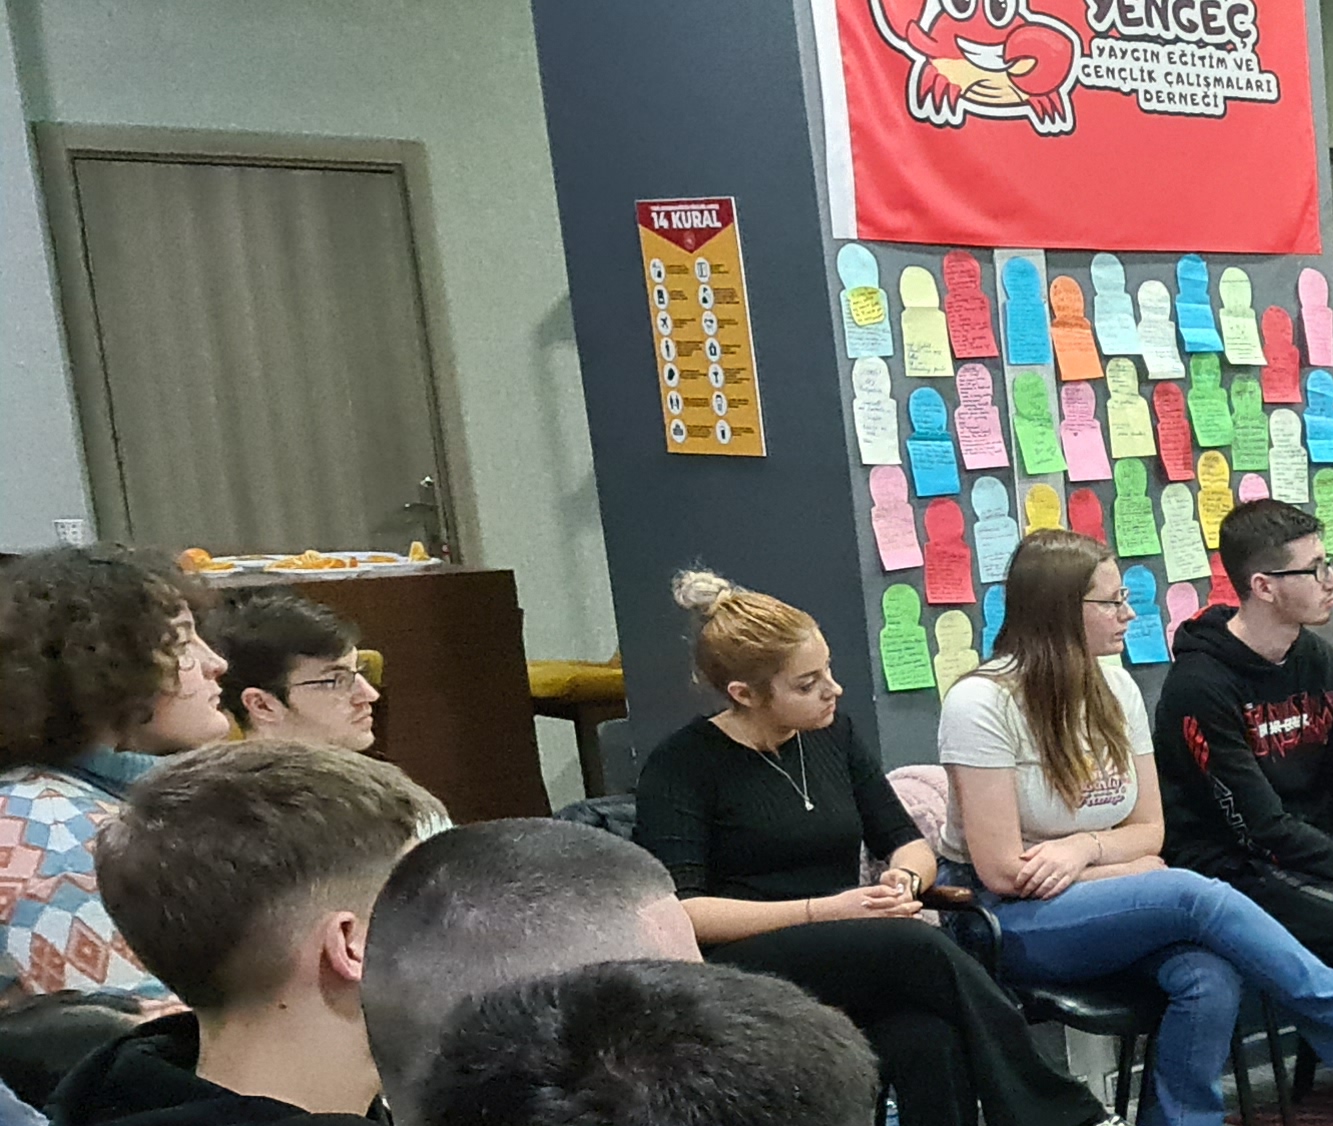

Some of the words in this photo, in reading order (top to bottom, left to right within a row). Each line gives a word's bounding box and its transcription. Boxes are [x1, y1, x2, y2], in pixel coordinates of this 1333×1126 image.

[1096, 45, 1160, 63] YAYGIN
[1167, 49, 1227, 69] EĞİTİM
[1233, 58, 1254, 71] VE
[1081, 64, 1157, 84] GENÇLİK
[1143, 88, 1219, 108] DERNEĞİ
[651, 212, 669, 229] 14
[671, 210, 722, 229] KURAL
